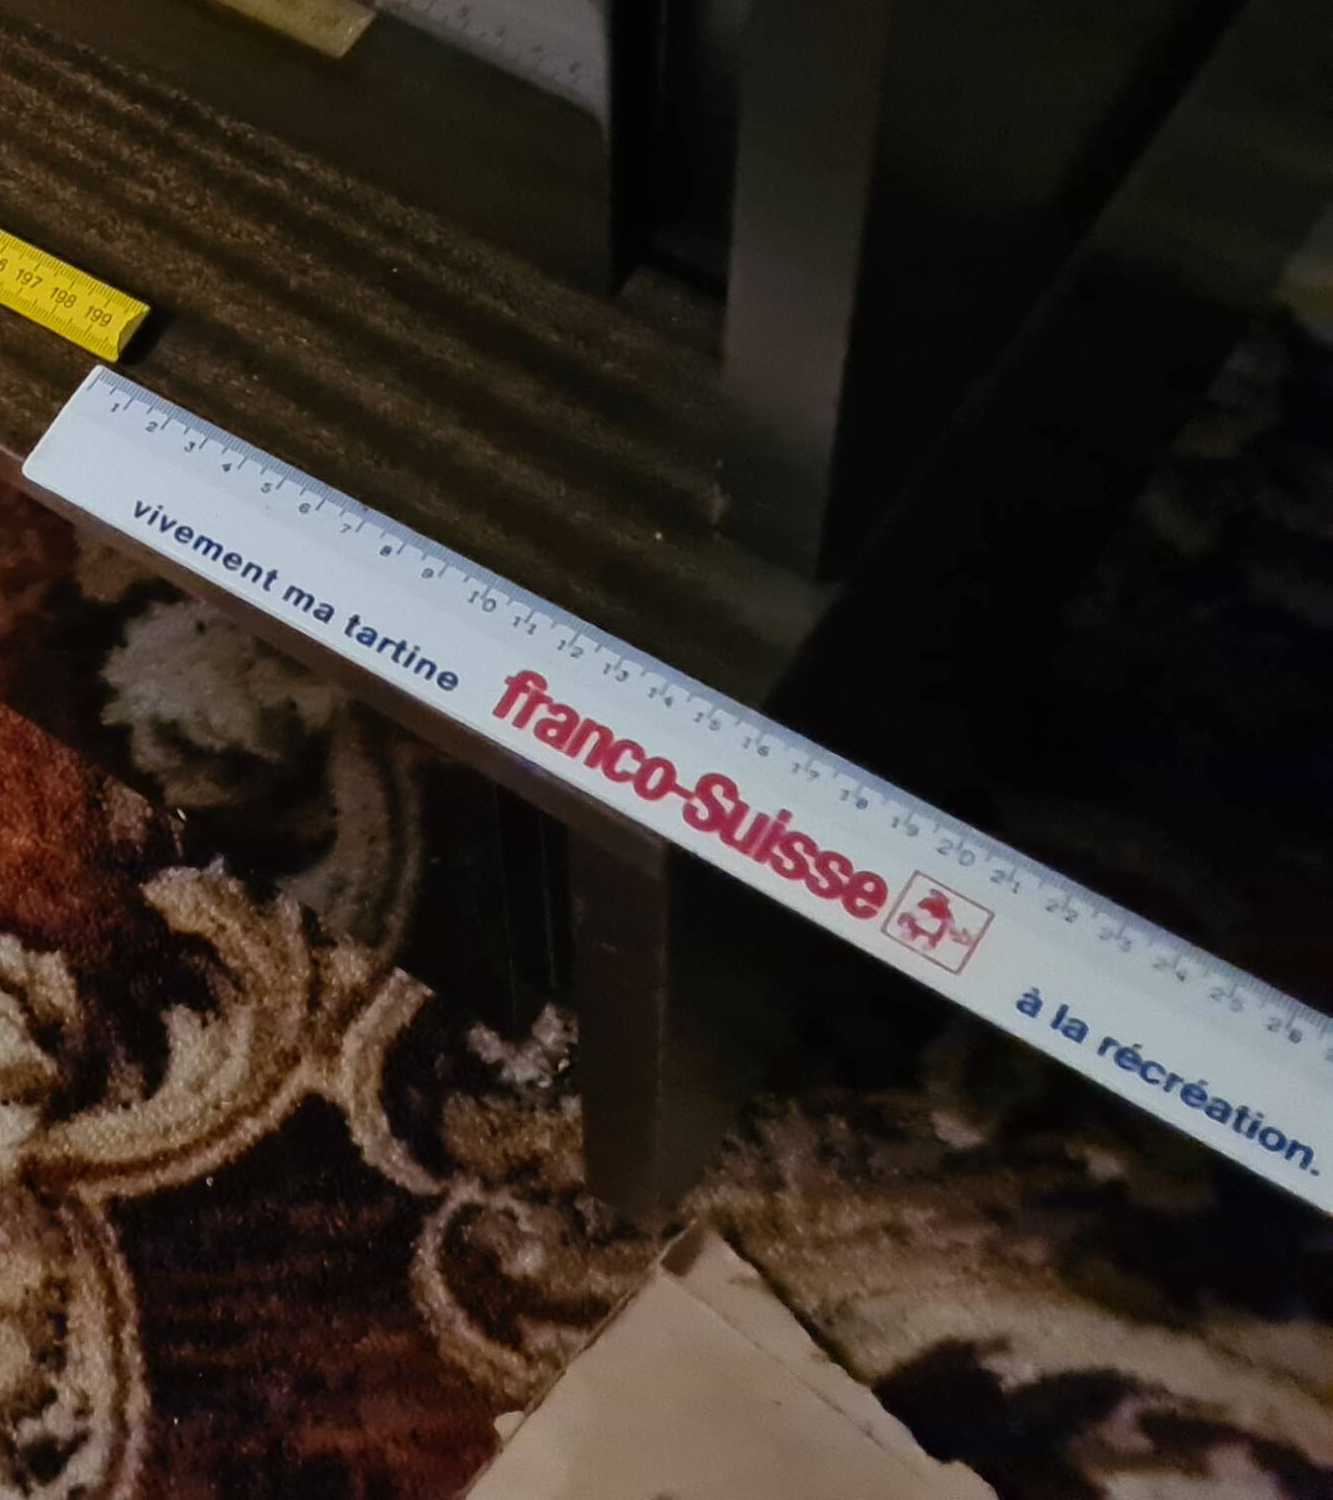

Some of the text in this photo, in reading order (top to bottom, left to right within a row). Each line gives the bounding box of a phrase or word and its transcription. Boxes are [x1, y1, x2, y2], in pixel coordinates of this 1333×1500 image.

[15, 269, 43, 289] 197
[49, 287, 77, 309] 198
[84, 305, 113, 327] 199
[111, 402, 120, 413] 1
[145, 420, 158, 433] 2
[184, 441, 196, 452] 3
[222, 462, 232, 473] 4
[261, 482, 273, 493] 5
[298, 502, 311, 514] 6
[339, 522, 352, 534] 7
[467, 590, 497, 612] 10
[513, 616, 537, 635] 11
[557, 639, 585, 659] 12
[133, 499, 1320, 1177] vivement ma tartine franco-Suisse à la récréation.
